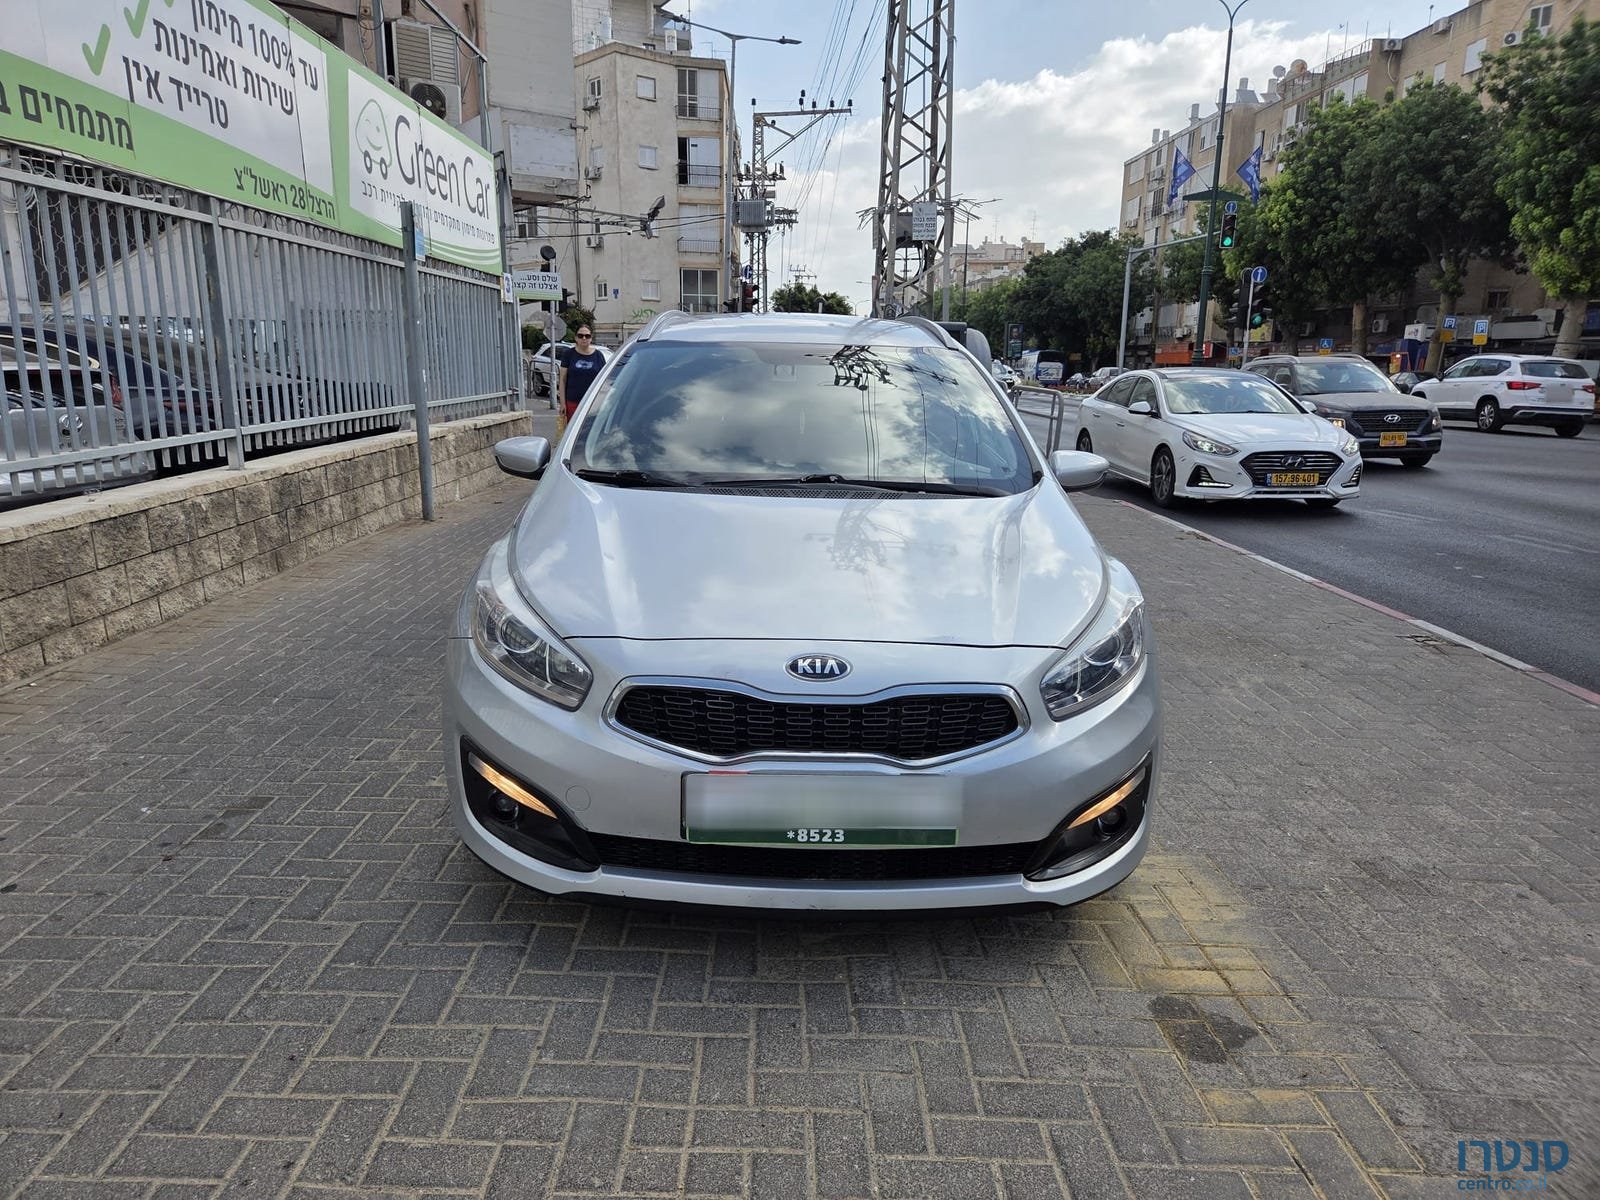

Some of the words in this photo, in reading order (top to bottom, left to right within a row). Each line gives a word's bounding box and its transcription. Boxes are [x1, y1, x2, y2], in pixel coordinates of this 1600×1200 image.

[190, 0, 243, 48] מימון
[152, 17, 238, 90] ואמינות
[248, 23, 297, 79] 100%
[299, 56, 319, 92] עד
[122, 55, 164, 105] אין
[169, 76, 229, 130] טרייד
[242, 65, 295, 116] שירות
[18, 84, 134, 151] מתמחים
[361, 180, 378, 200] רכב
[394, 114, 461, 206] Green
[462, 156, 491, 220] Car
[290, 184, 306, 210] 28
[308, 189, 336, 220] הרצל
[539, 281, 558, 290] אצלנו
[542, 274, 558, 283] שלם
[797, 657, 841, 675] KIA
